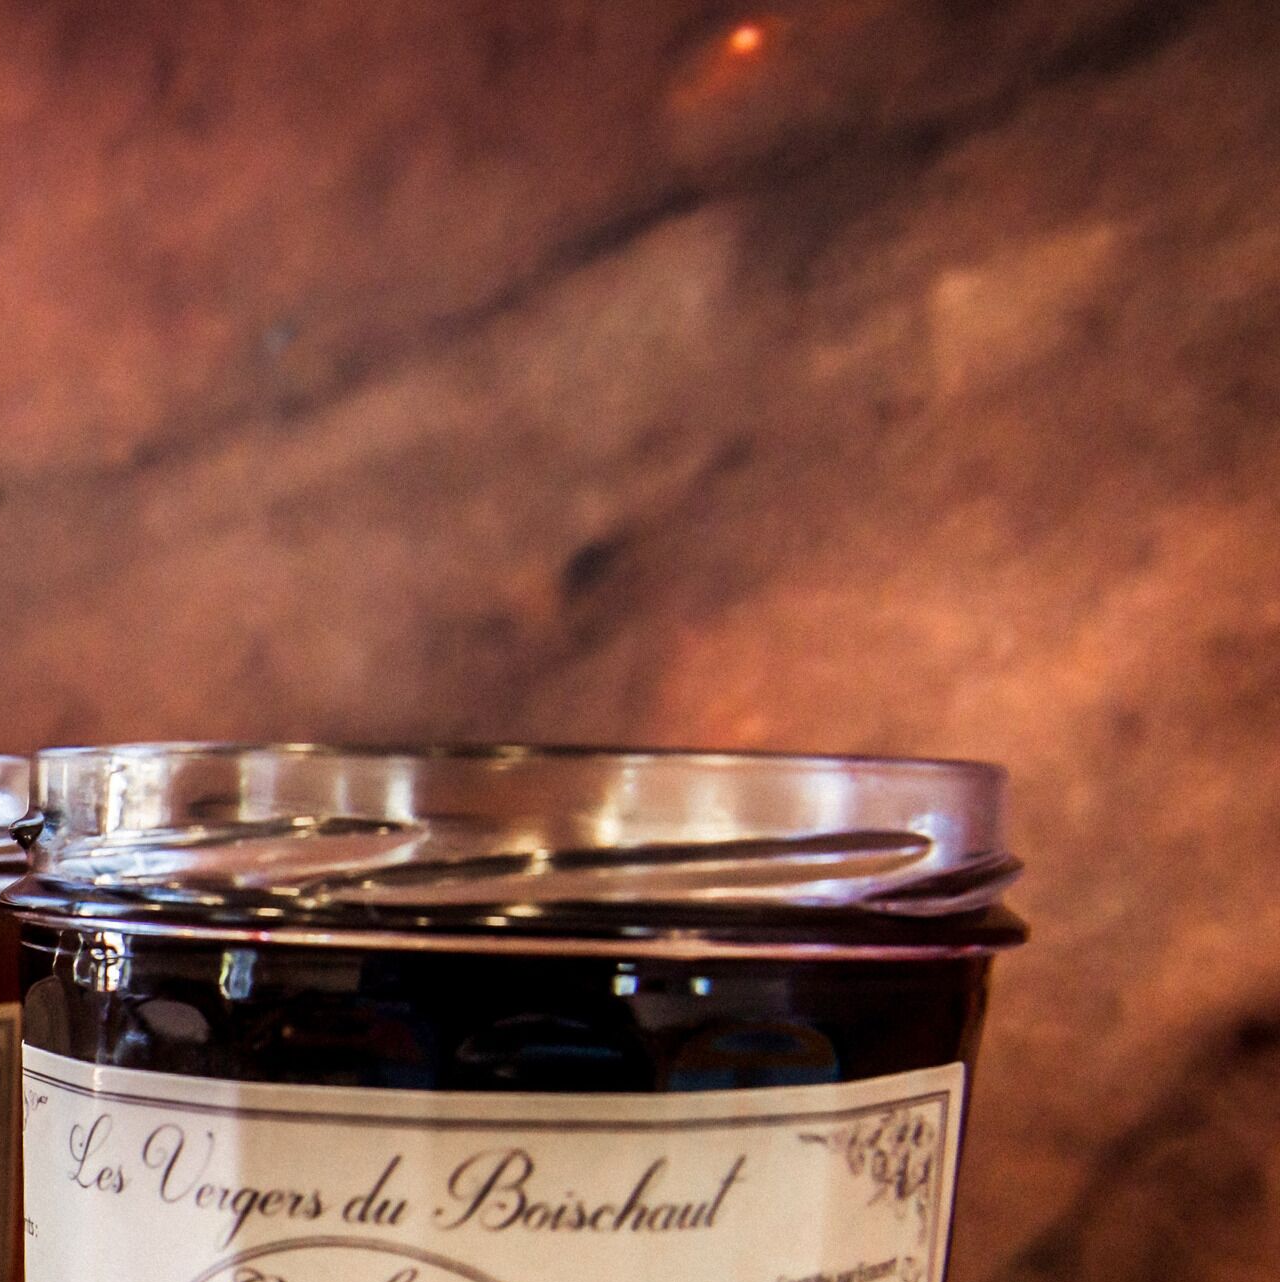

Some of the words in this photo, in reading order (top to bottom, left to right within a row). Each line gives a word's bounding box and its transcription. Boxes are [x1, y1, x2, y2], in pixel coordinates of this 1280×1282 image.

[67, 1113, 128, 1195] Les
[141, 1122, 323, 1251] Vergers
[343, 1154, 408, 1227] du
[435, 1146, 747, 1233] Boischaut
